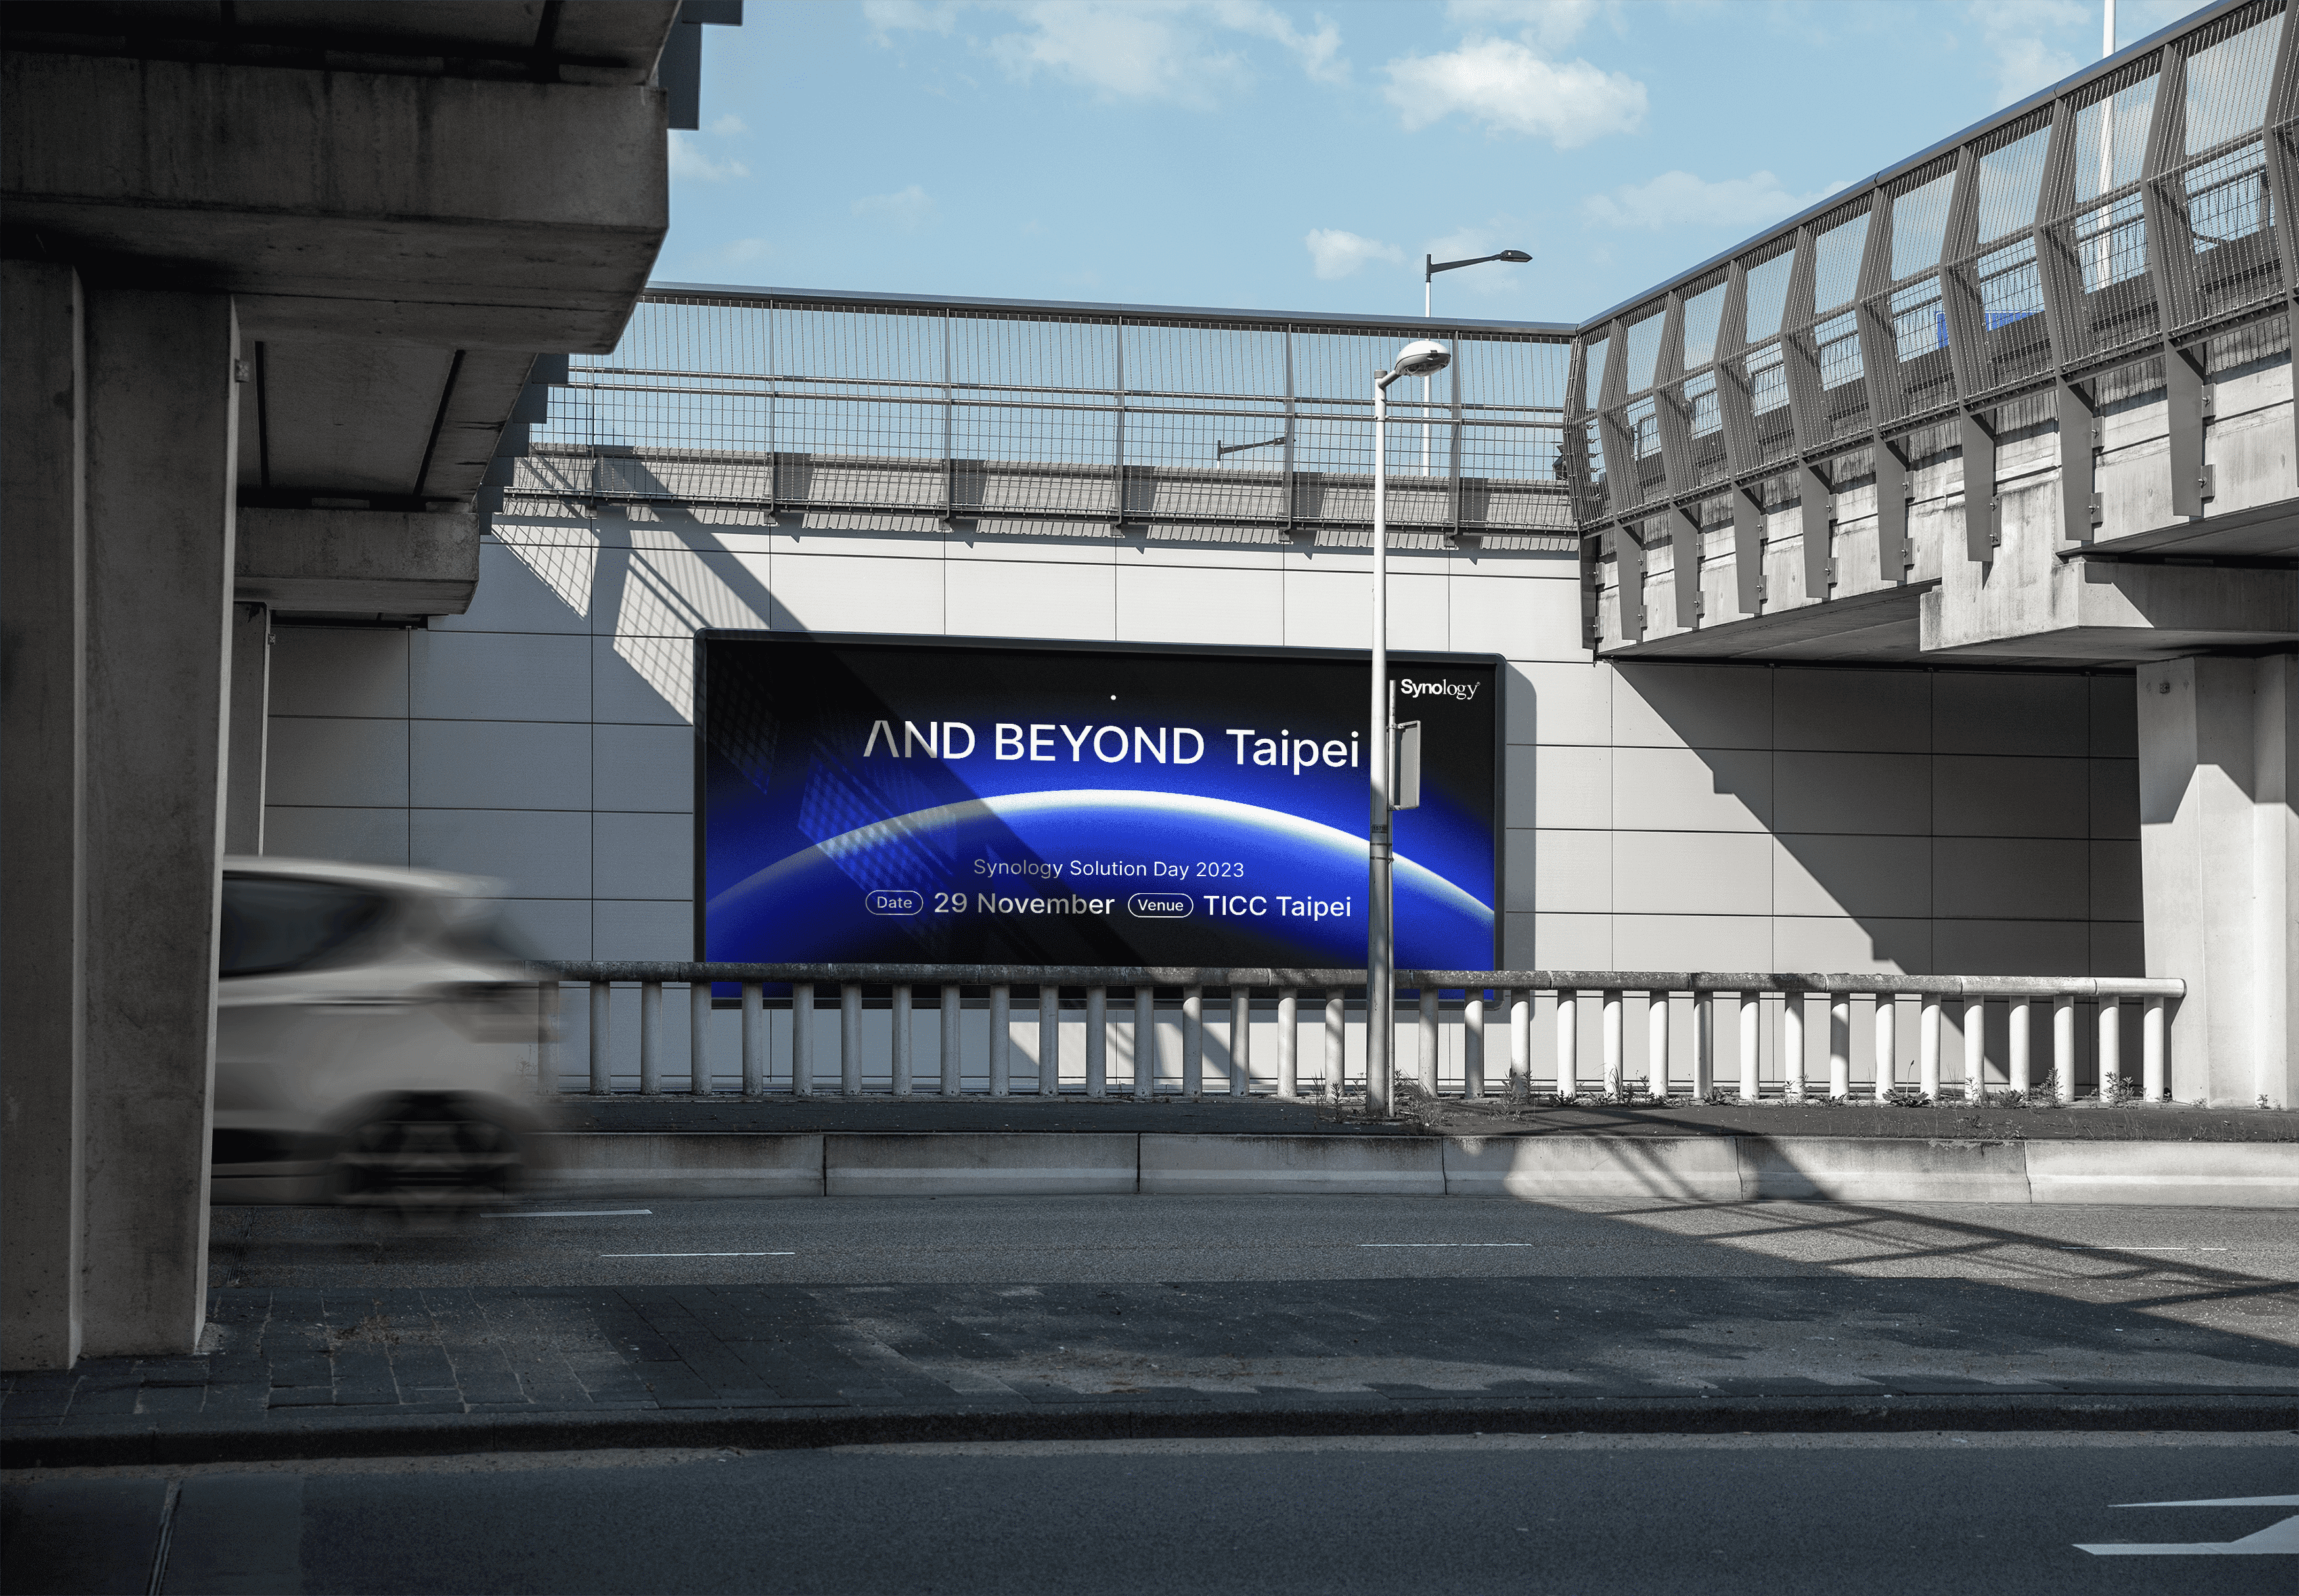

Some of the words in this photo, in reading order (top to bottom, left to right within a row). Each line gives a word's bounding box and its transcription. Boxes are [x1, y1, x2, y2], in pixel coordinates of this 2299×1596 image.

[996, 723, 1204, 763] BEYOND
[1226, 728, 1358, 775] Taipei
[973, 858, 1063, 879] Synology
[1070, 860, 1147, 876] Solution
[1153, 861, 1189, 880] Day
[1196, 862, 1244, 877] 2023
[877, 896, 912, 908] Date
[934, 893, 968, 913] 29
[978, 893, 1115, 914] November
[1138, 899, 1184, 911] Venue
[1203, 895, 1267, 916] TICC
[1276, 896, 1351, 921] Taipei
